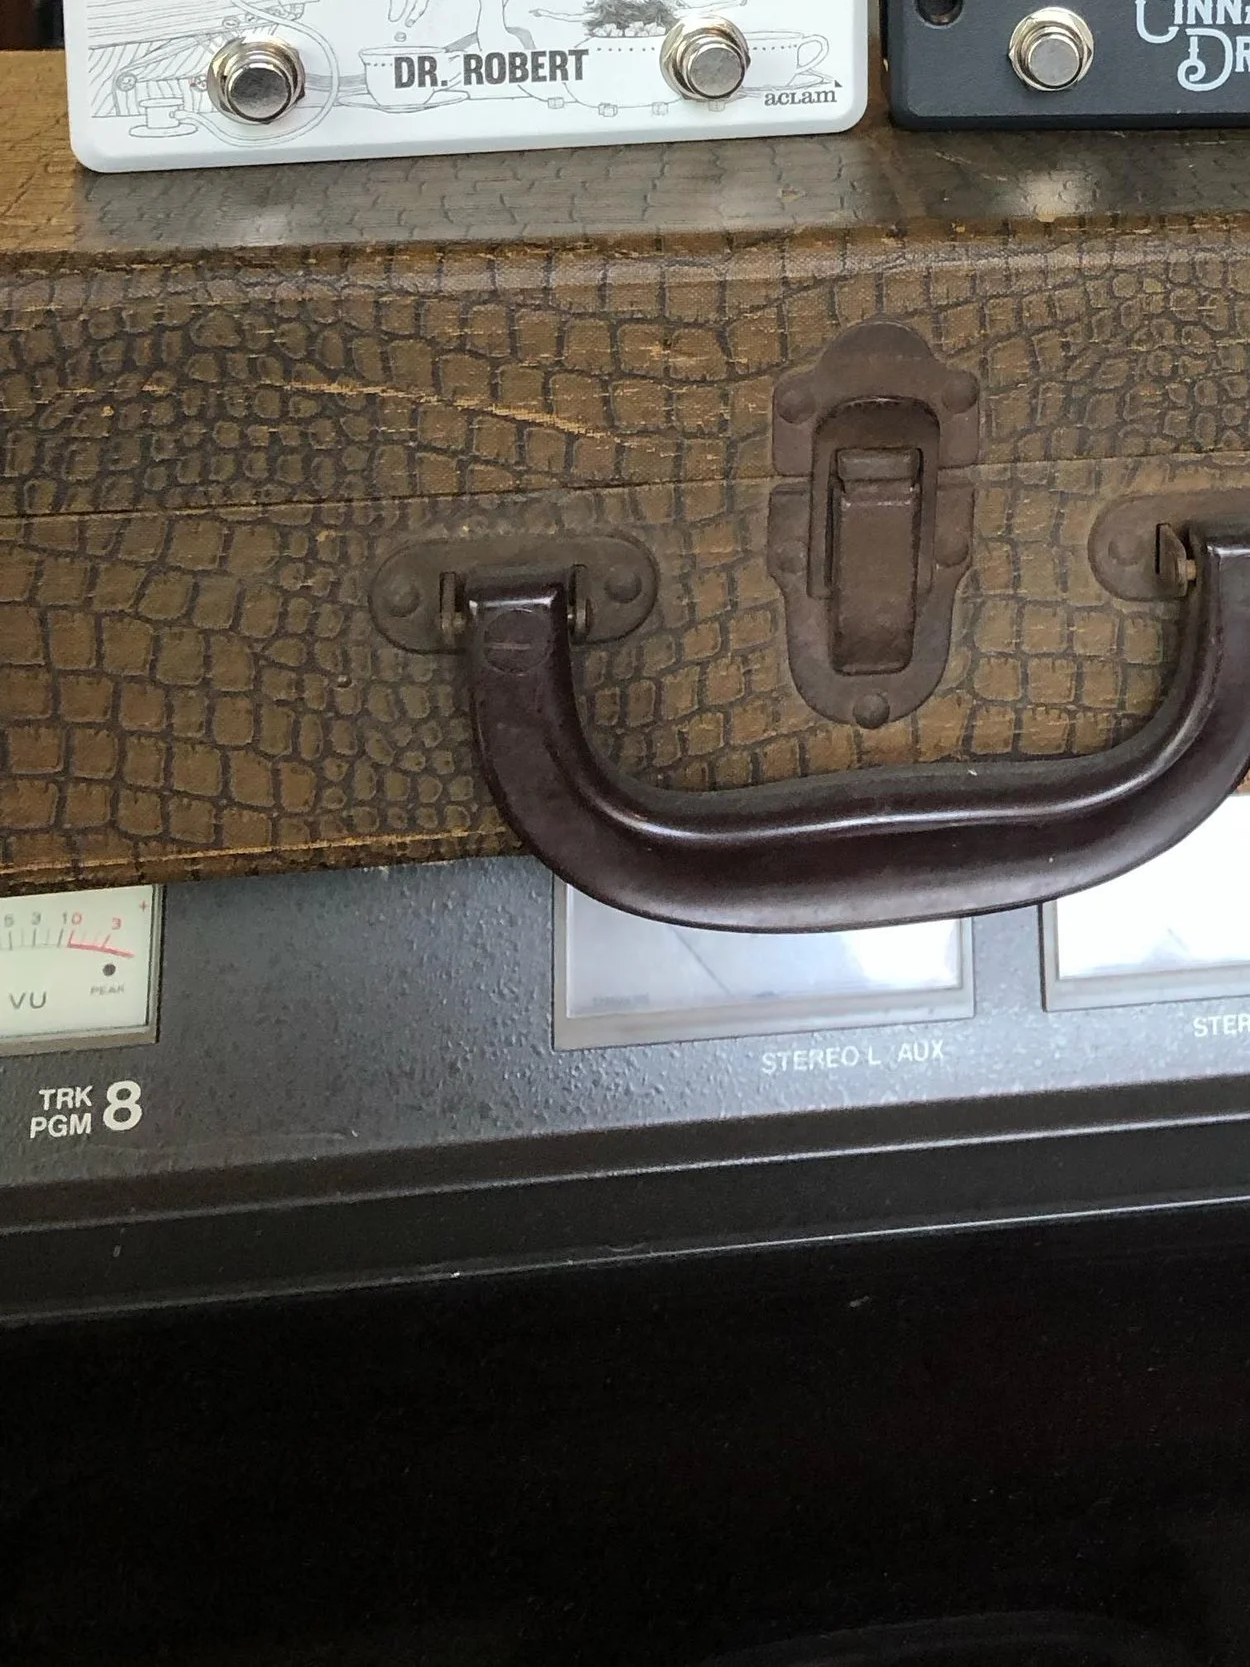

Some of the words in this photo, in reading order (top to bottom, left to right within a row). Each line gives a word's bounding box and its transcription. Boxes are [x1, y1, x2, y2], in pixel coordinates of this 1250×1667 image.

[394, 55, 448, 89] DR.
[462, 49, 589, 86] ROBERT
[9, 991, 47, 1010] VU
[761, 1046, 860, 1074] STEREO
[39, 1085, 93, 1110] TRK
[103, 1080, 143, 1131] 8
[30, 1113, 92, 1139] PGM
